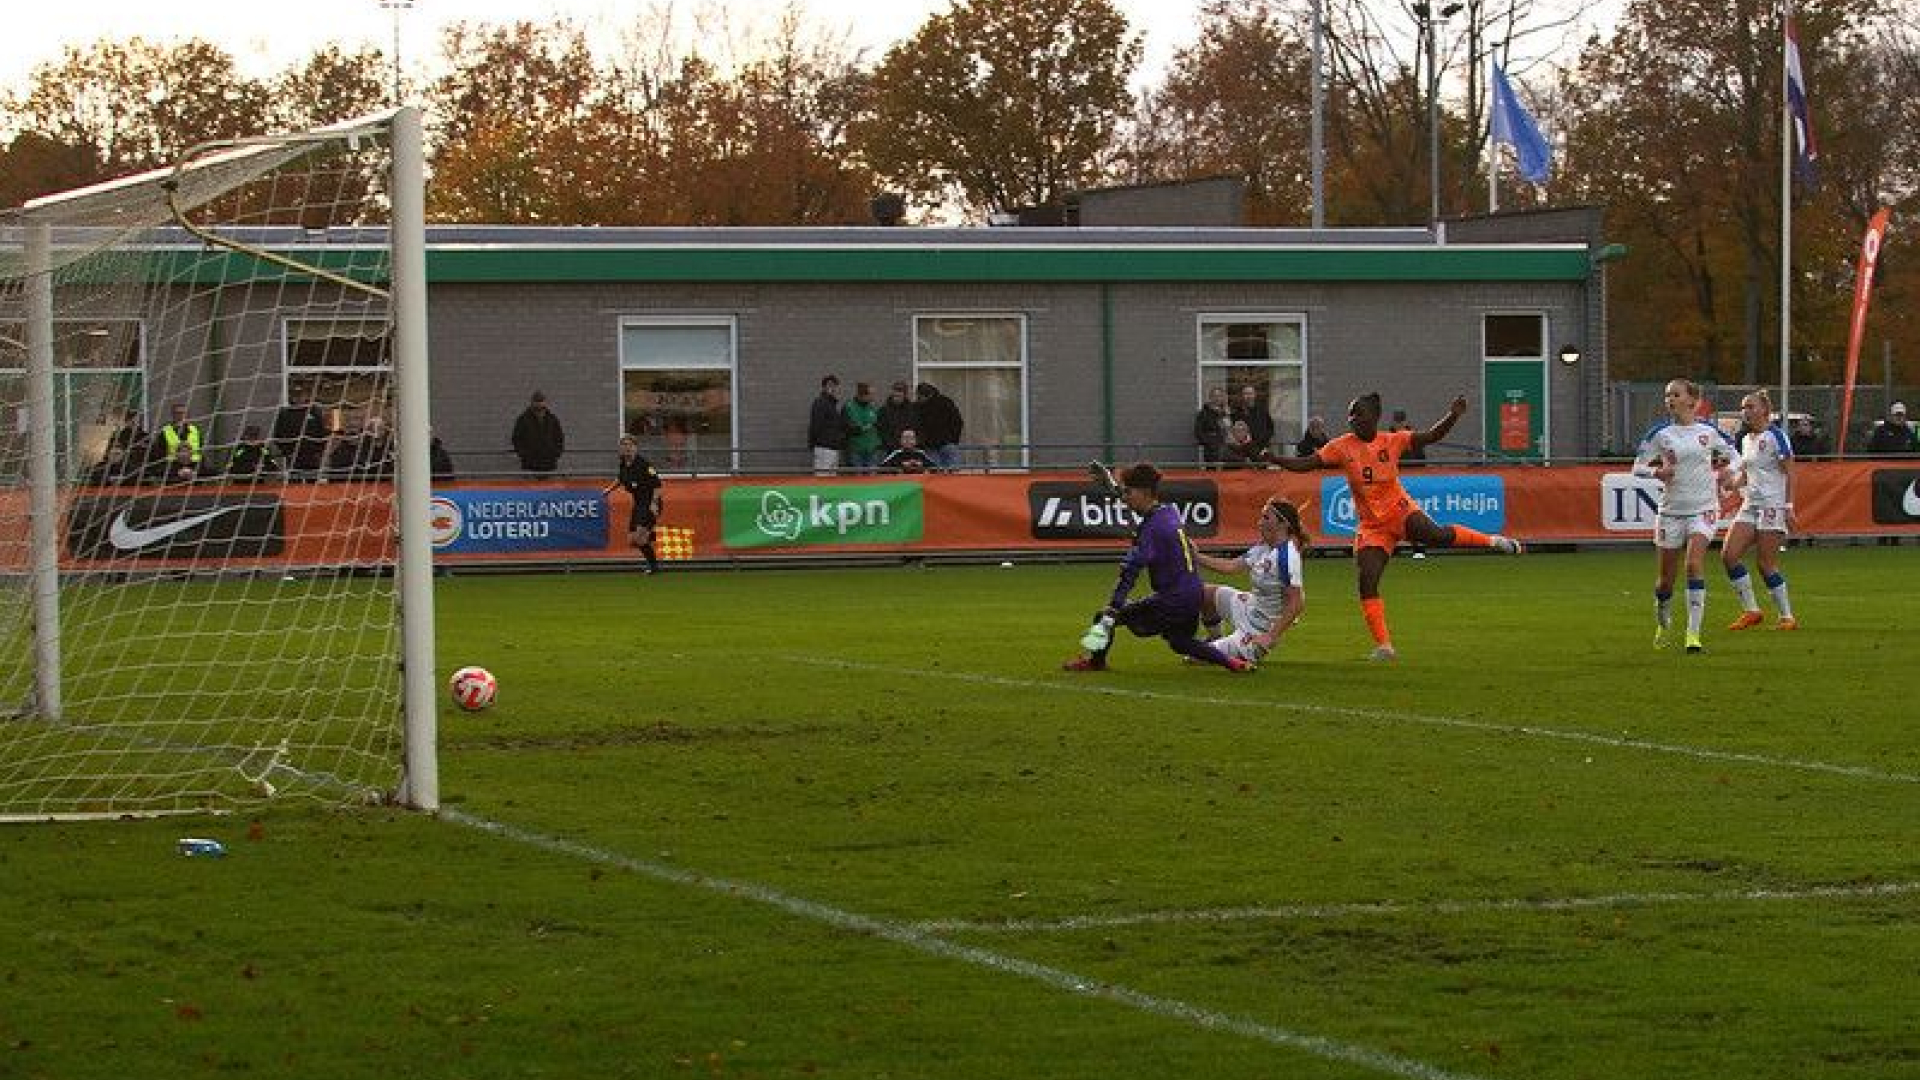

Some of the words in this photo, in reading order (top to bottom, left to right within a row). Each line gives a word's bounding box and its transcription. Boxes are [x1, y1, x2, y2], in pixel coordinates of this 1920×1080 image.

[1362, 466, 1373, 484] 9
[468, 500, 599, 518] NEDERLANDSE
[809, 494, 889, 535] kpn
[1080, 495, 1214, 525] bitvvo
[1446, 493, 1498, 515] Heijn
[1612, 487, 1664, 523] IN
[468, 521, 549, 539] LOTERIJ
